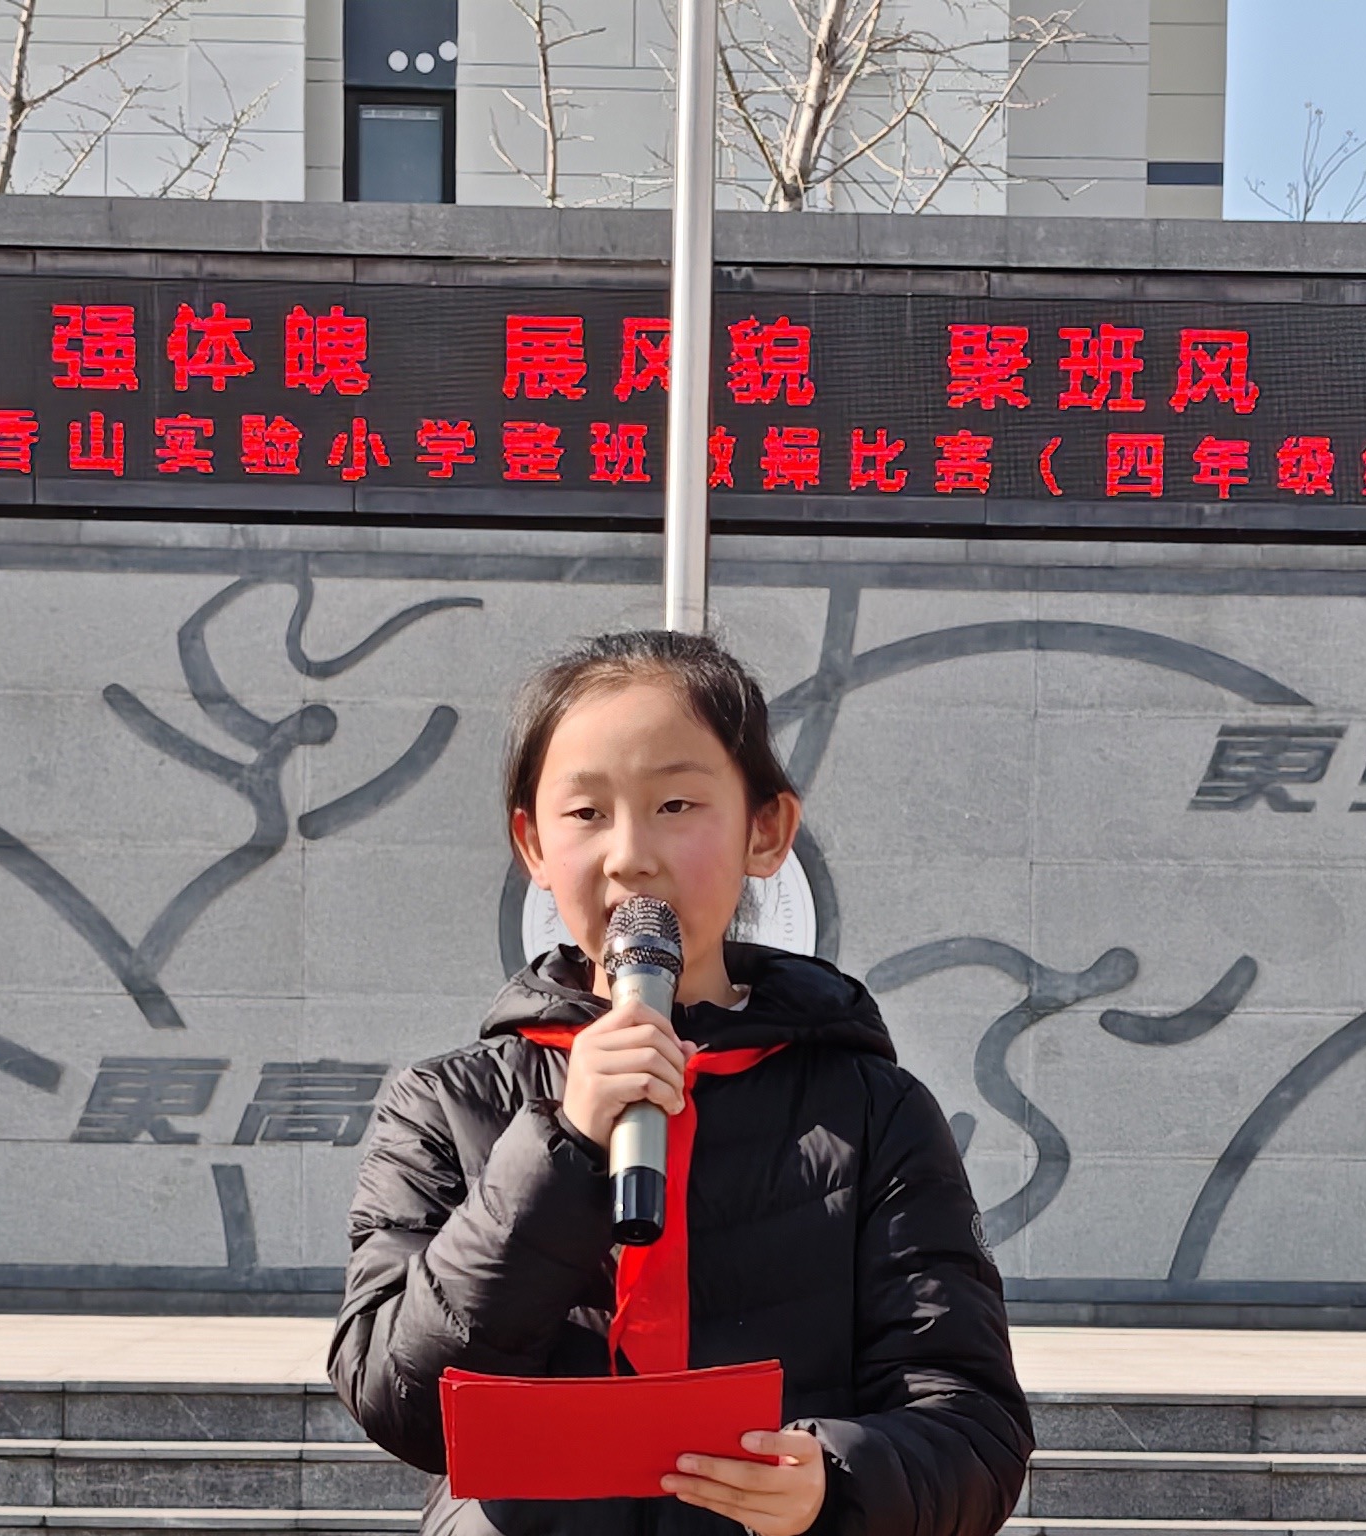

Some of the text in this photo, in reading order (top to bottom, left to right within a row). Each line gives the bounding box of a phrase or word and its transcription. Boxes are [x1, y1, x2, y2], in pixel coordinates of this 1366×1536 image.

[49, 302, 1260, 413] 强体魄 展风貌 聚班风
[69, 1056, 390, 1147] 更高
